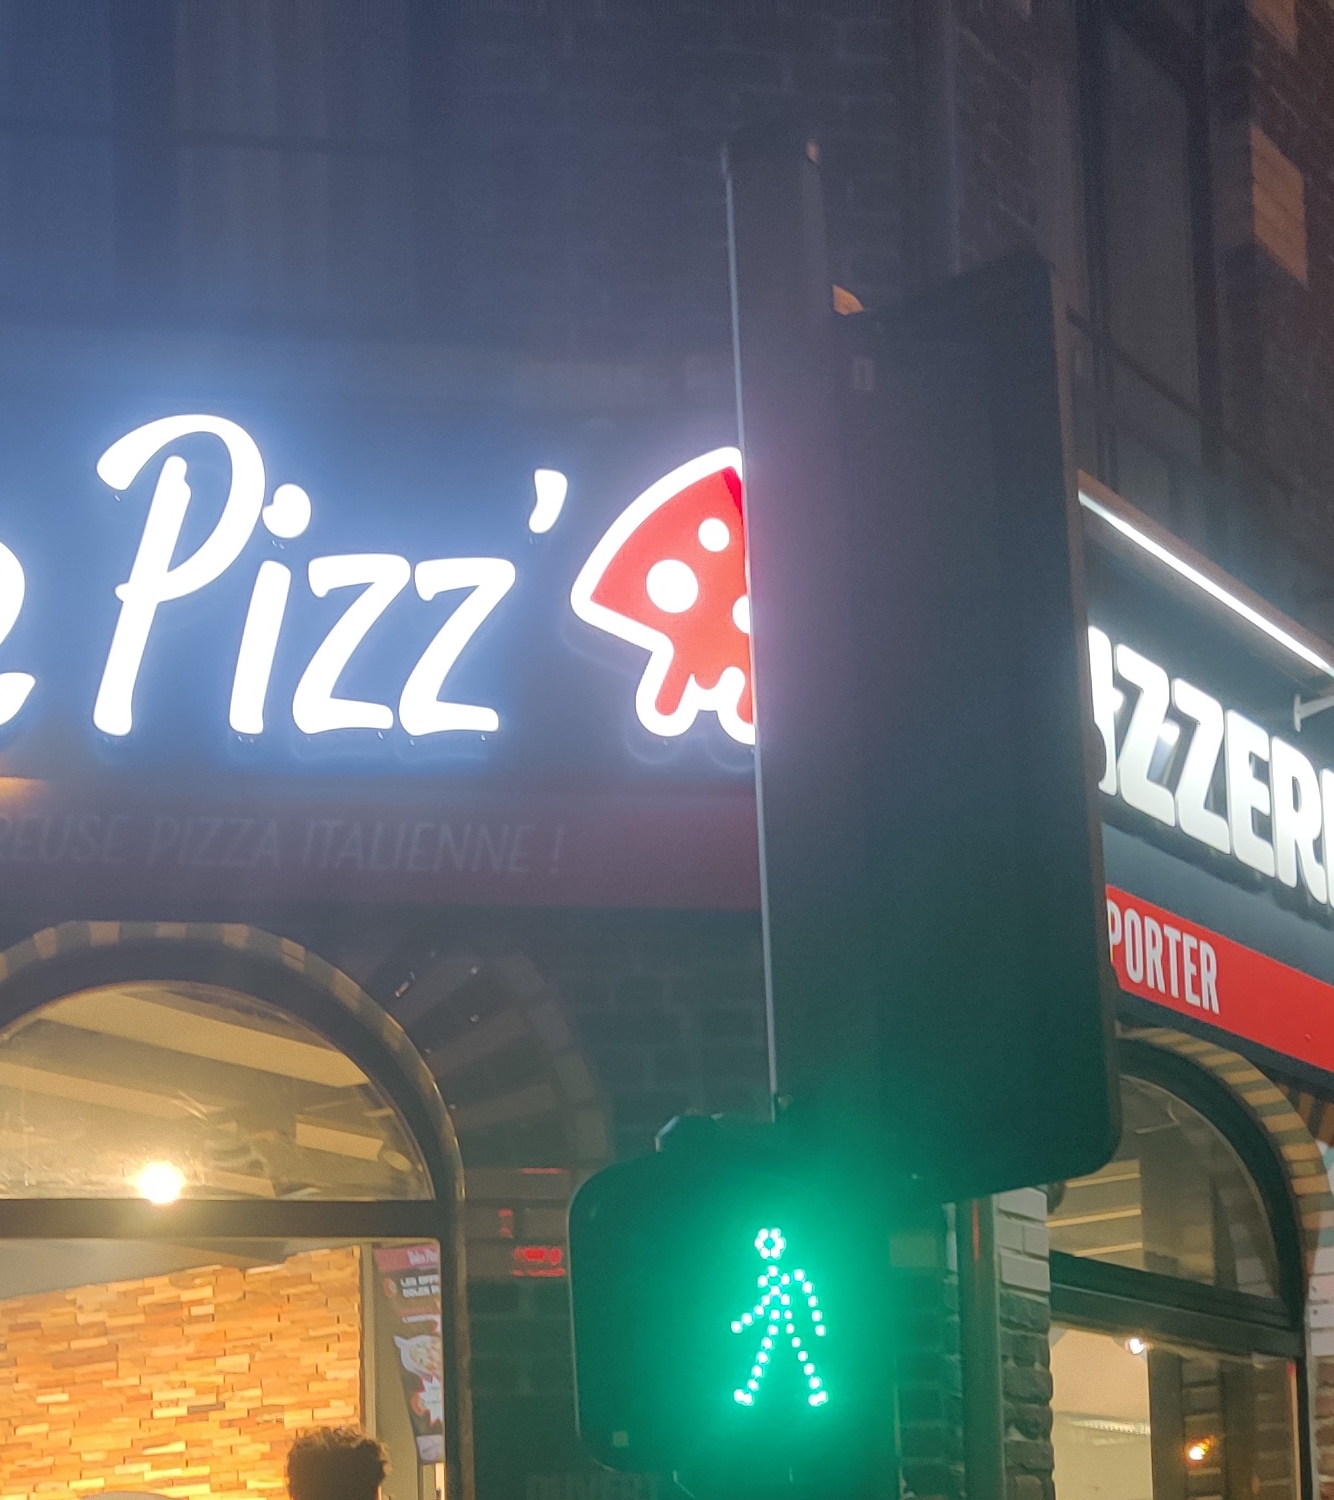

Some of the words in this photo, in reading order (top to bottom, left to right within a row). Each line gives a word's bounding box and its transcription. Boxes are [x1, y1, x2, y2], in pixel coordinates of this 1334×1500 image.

[92, 414, 567, 736] Pizz'
[147, 812, 279, 868] PIZZA
[304, 819, 534, 872] ITALIENNE
[1106, 898, 1220, 1015] PORTER
